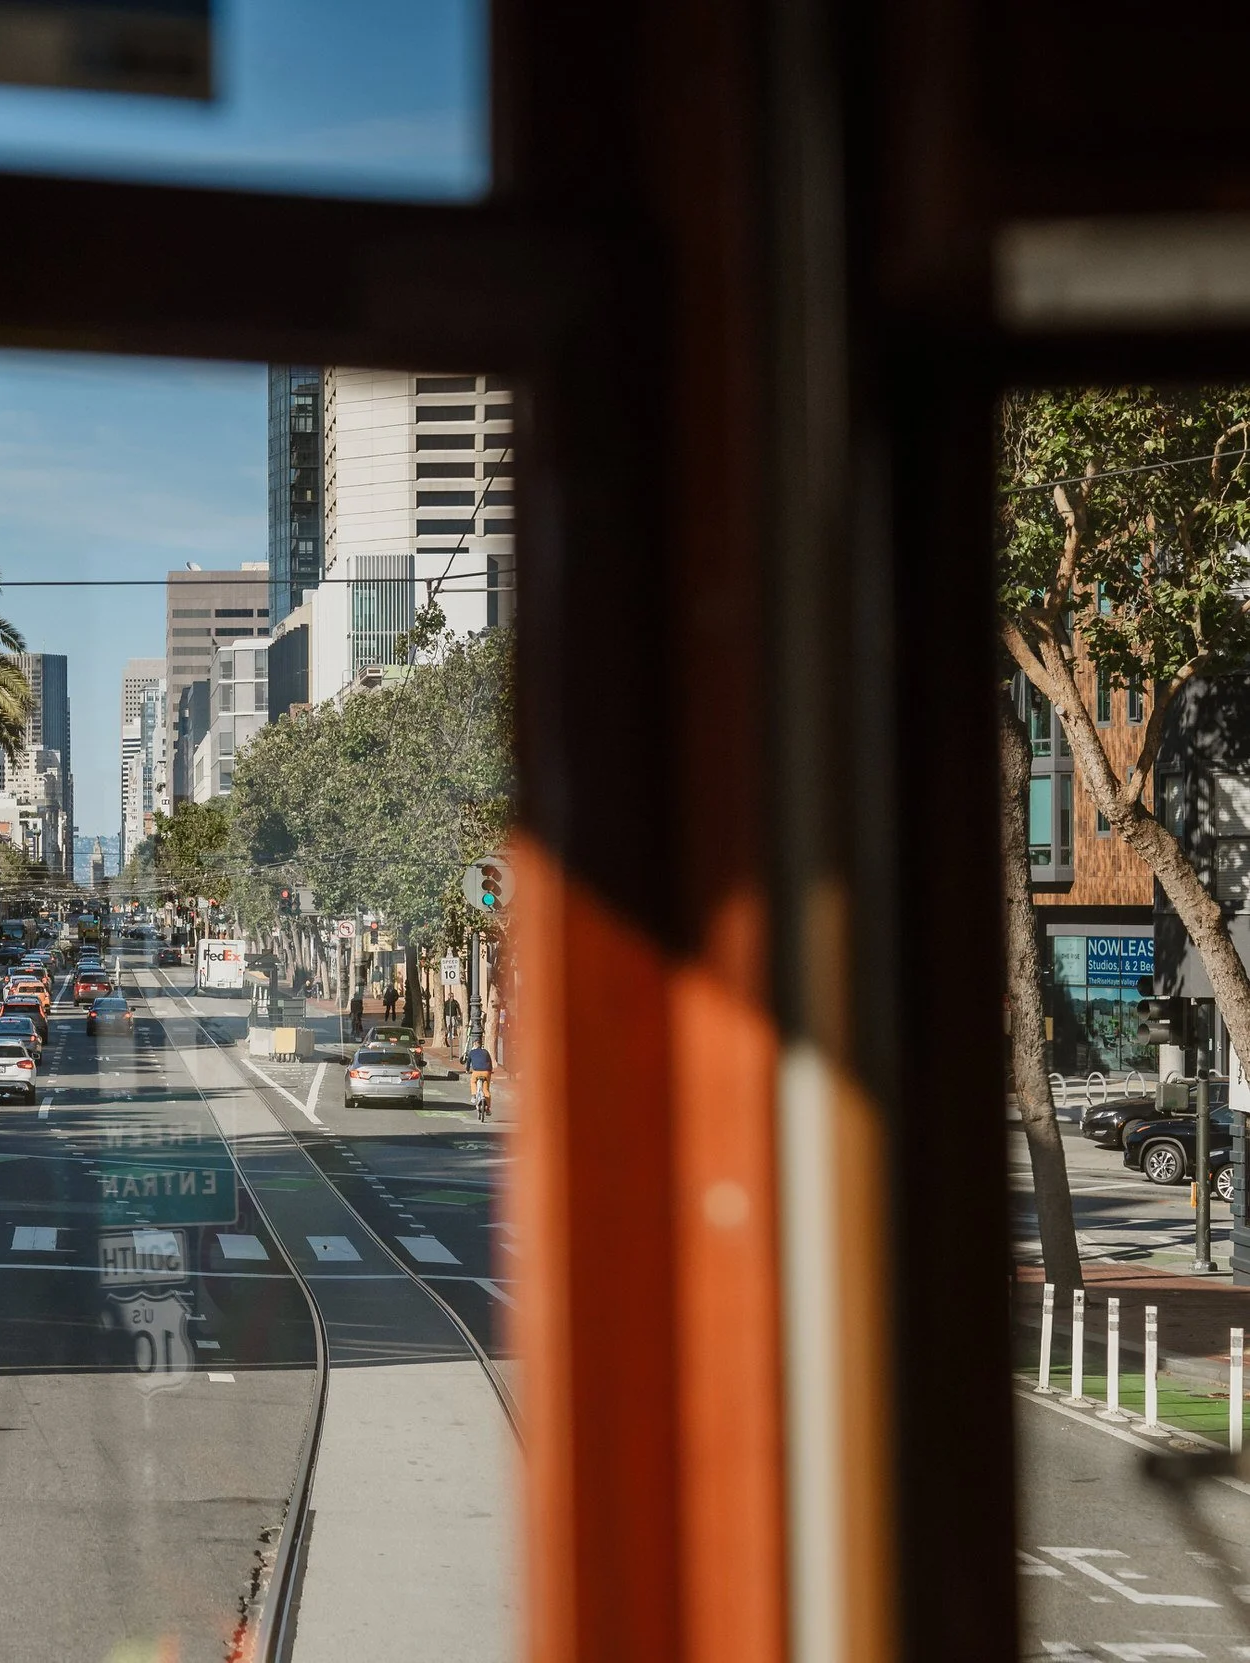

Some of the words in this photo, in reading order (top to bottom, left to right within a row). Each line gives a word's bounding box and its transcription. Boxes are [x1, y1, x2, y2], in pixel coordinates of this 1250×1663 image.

[203, 949, 241, 962] FedEx
[1088, 960, 1120, 972] Studios,
[1125, 962, 1132, 970] &
[1133, 961, 1138, 970] 2
[444, 970, 456, 980] 10
